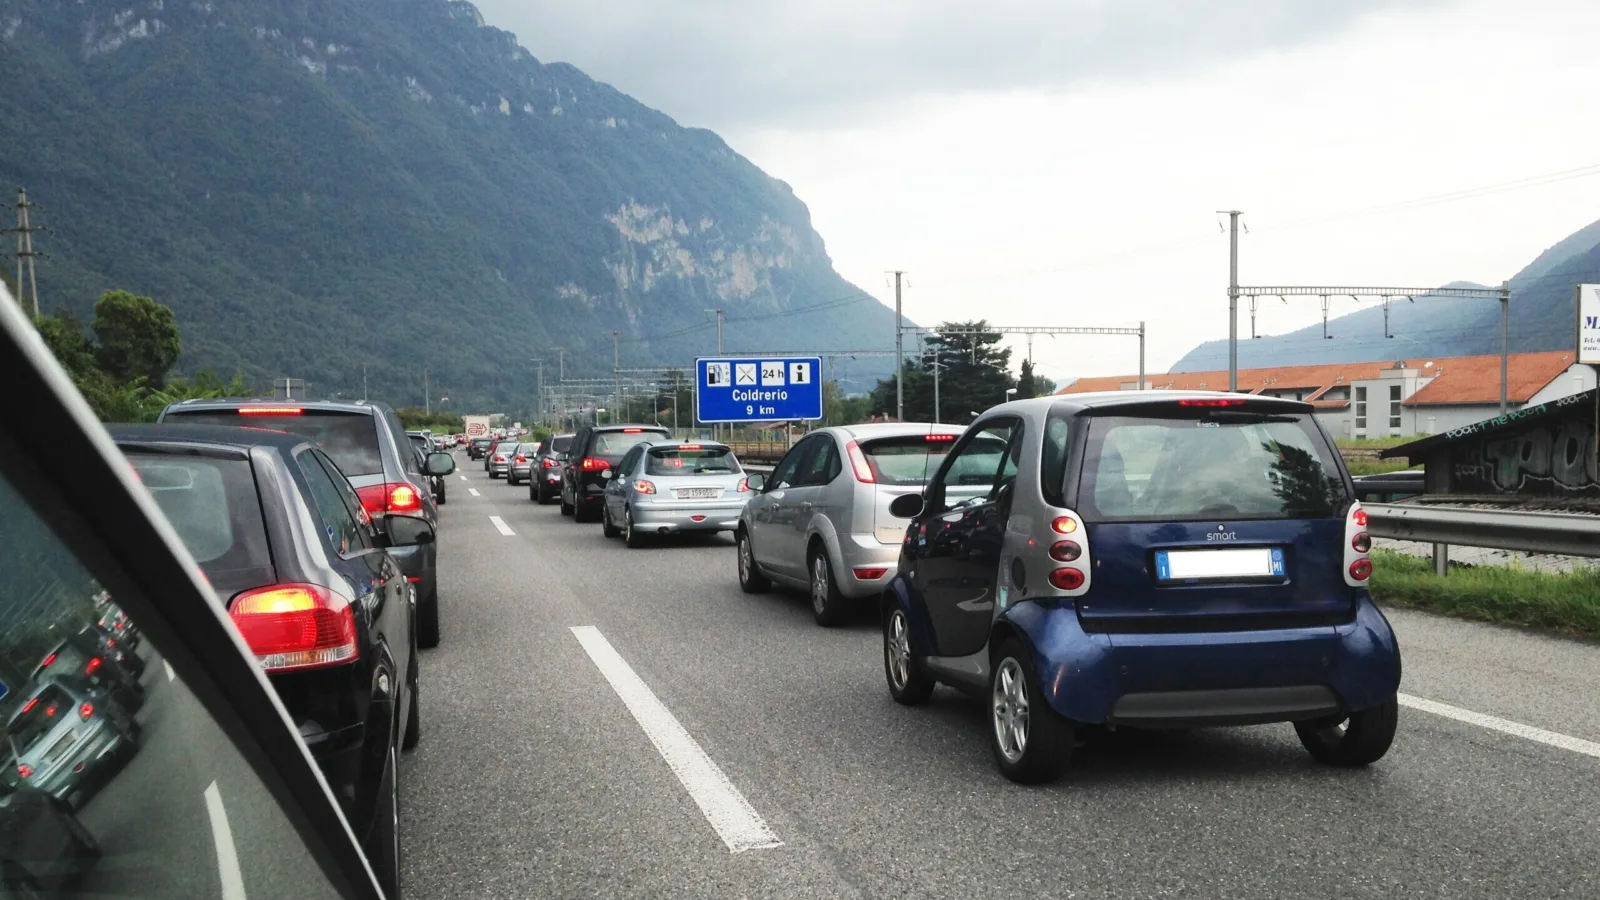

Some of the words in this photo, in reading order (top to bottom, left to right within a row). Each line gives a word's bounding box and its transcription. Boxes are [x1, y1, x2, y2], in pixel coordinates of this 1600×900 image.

[762, 369, 775, 379] 24
[778, 369, 784, 378] h
[732, 389, 788, 401] Coldrerio
[746, 405, 753, 415] 9
[760, 405, 775, 415] km
[1206, 531, 1237, 541] smart
[1273, 561, 1283, 572] MI
